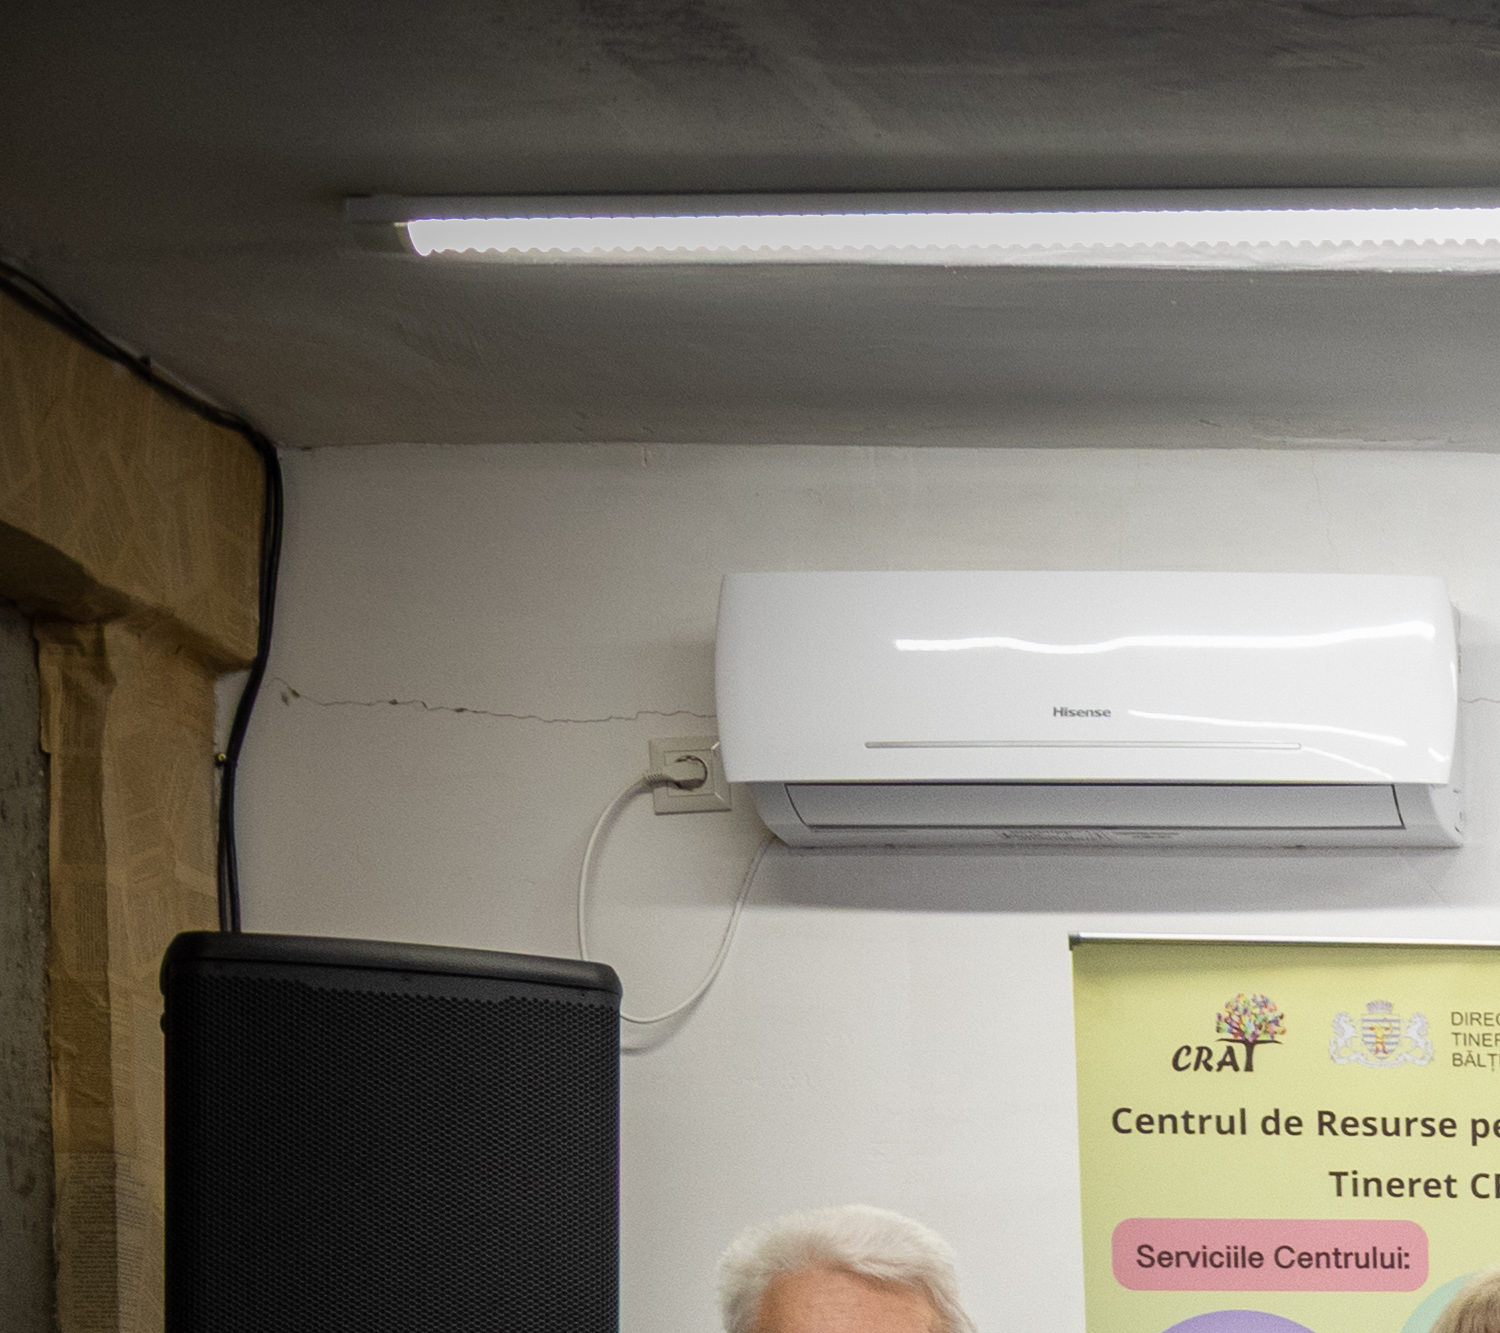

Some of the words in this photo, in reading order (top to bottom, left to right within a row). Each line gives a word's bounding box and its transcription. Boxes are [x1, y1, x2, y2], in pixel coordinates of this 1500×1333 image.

[1053, 706, 1112, 718] Hisense
[1111, 1107, 1247, 1136] Centrul
[1260, 1108, 1304, 1136] de
[1317, 1110, 1457, 1138] Resurse
[1328, 1170, 1458, 1199] Tineret
[1136, 1244, 1265, 1269] Serviciile
[1274, 1245, 1411, 1270] Centrului:
